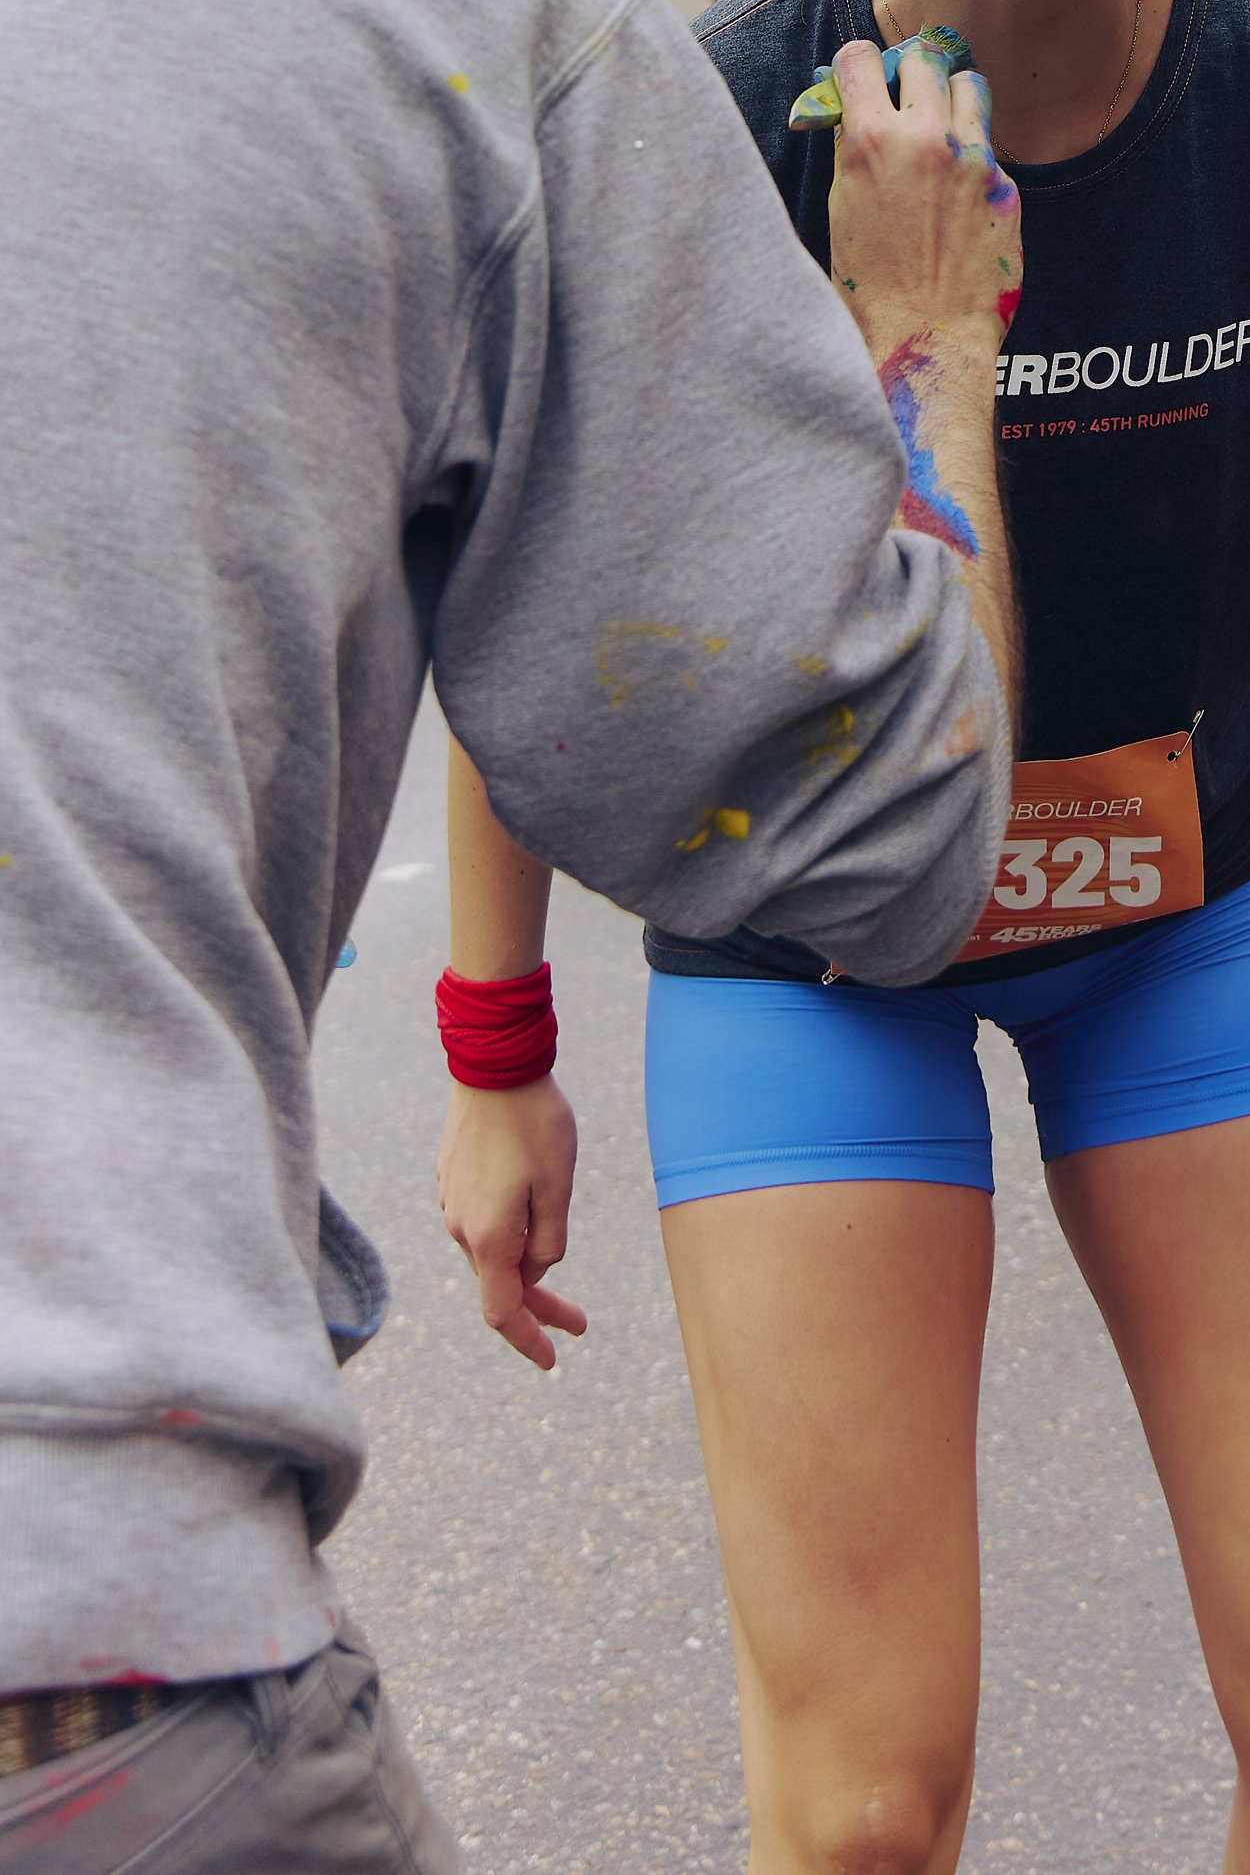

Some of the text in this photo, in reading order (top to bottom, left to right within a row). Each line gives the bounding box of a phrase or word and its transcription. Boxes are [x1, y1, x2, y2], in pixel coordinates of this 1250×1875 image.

[1001, 423, 1034, 440] EST
[1039, 420, 1076, 438] 1979
[1089, 416, 1132, 434] 45TH
[1137, 402, 1209, 429] RUNNING
[993, 835, 1162, 910] 325
[990, 927, 1041, 943] 45
[1038, 924, 1102, 934] YEARS
